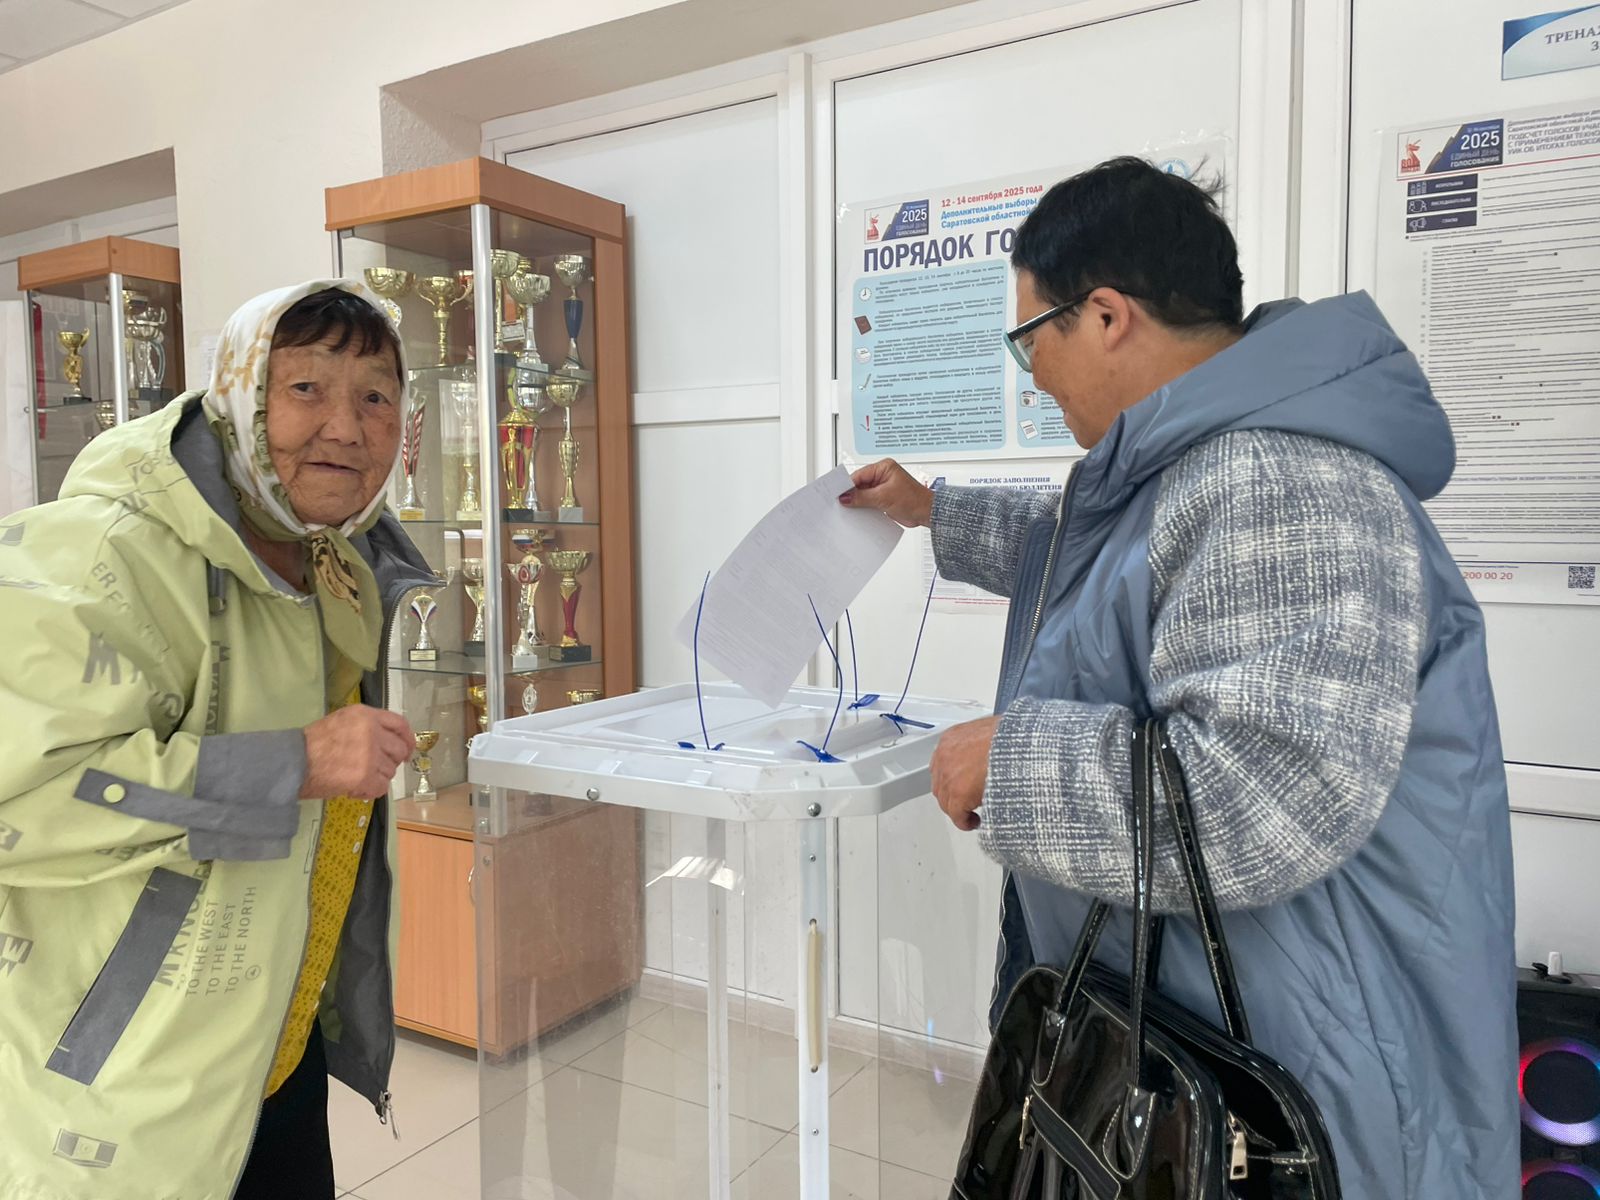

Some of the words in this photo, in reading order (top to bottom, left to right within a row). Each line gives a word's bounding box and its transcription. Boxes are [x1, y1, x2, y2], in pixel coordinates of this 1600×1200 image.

[1461, 131, 1500, 150] 2025
[941, 199, 951, 208] 12
[957, 196, 966, 205] 14
[967, 191, 1003, 203] сентября
[1004, 186, 1024, 198] 2025
[1026, 184, 1043, 195] года
[902, 208, 927, 223] 2025
[941, 203, 1003, 219] Дополнительные
[1005, 197, 1037, 209] выборы
[941, 214, 990, 229] Саратовской
[864, 234, 974, 272] ПОРЯДОК
[985, 228, 1017, 255] ГО
[1484, 572, 1497, 580] 00
[1500, 572, 1513, 580] 20
[199, 901, 219, 941] WEST
[218, 904, 236, 939] EAST
[237, 886, 257, 938] NORTH
[192, 945, 209, 973] THE
[211, 944, 227, 972] THE
[231, 944, 247, 973] THE
[185, 979, 200, 997] TO
[205, 977, 220, 996] TO
[224, 976, 239, 993] TO
